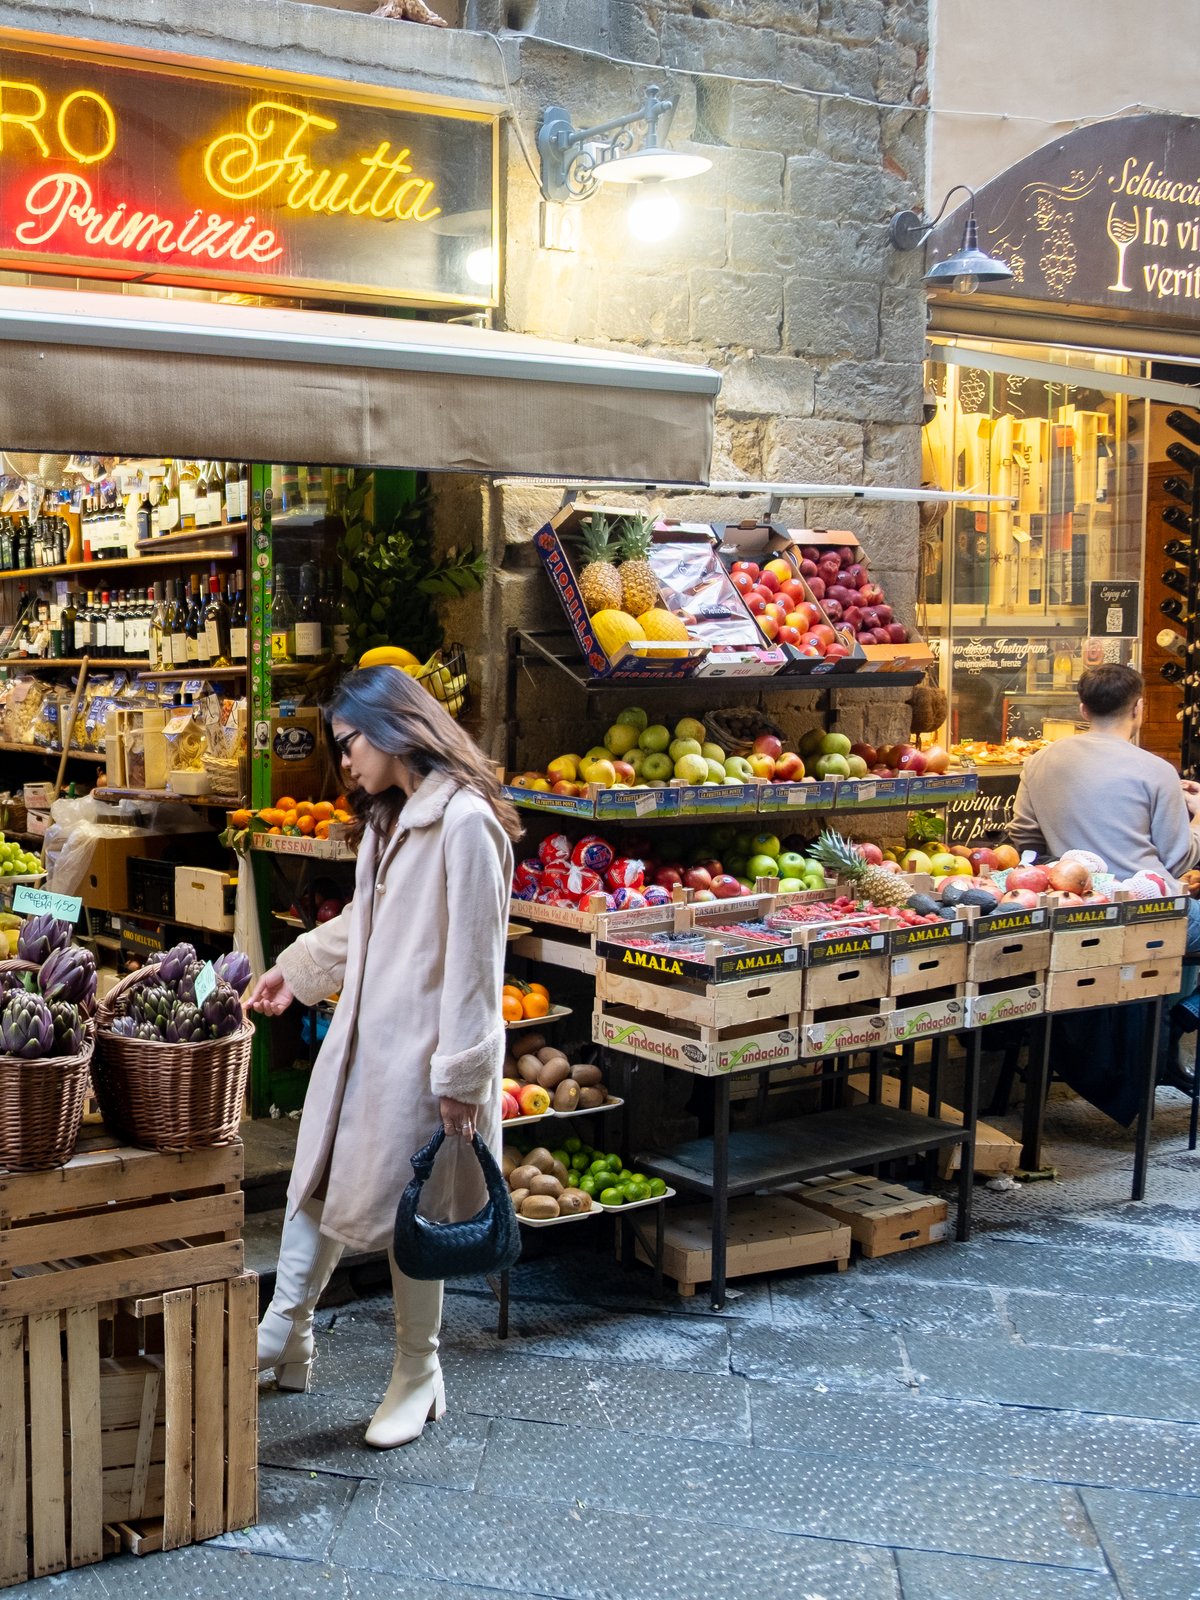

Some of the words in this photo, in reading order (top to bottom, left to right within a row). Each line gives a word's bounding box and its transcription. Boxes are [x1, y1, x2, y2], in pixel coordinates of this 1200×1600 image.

[203, 100, 442, 222] Frutta
[15, 171, 284, 263] Primizie
[1143, 206, 1169, 247] In
[548, 551, 593, 653] FIORILLA
[1100, 587, 1121, 601] Enjoy
[994, 639, 1049, 659] Instagram
[54, 899, 77, 912] 1,50
